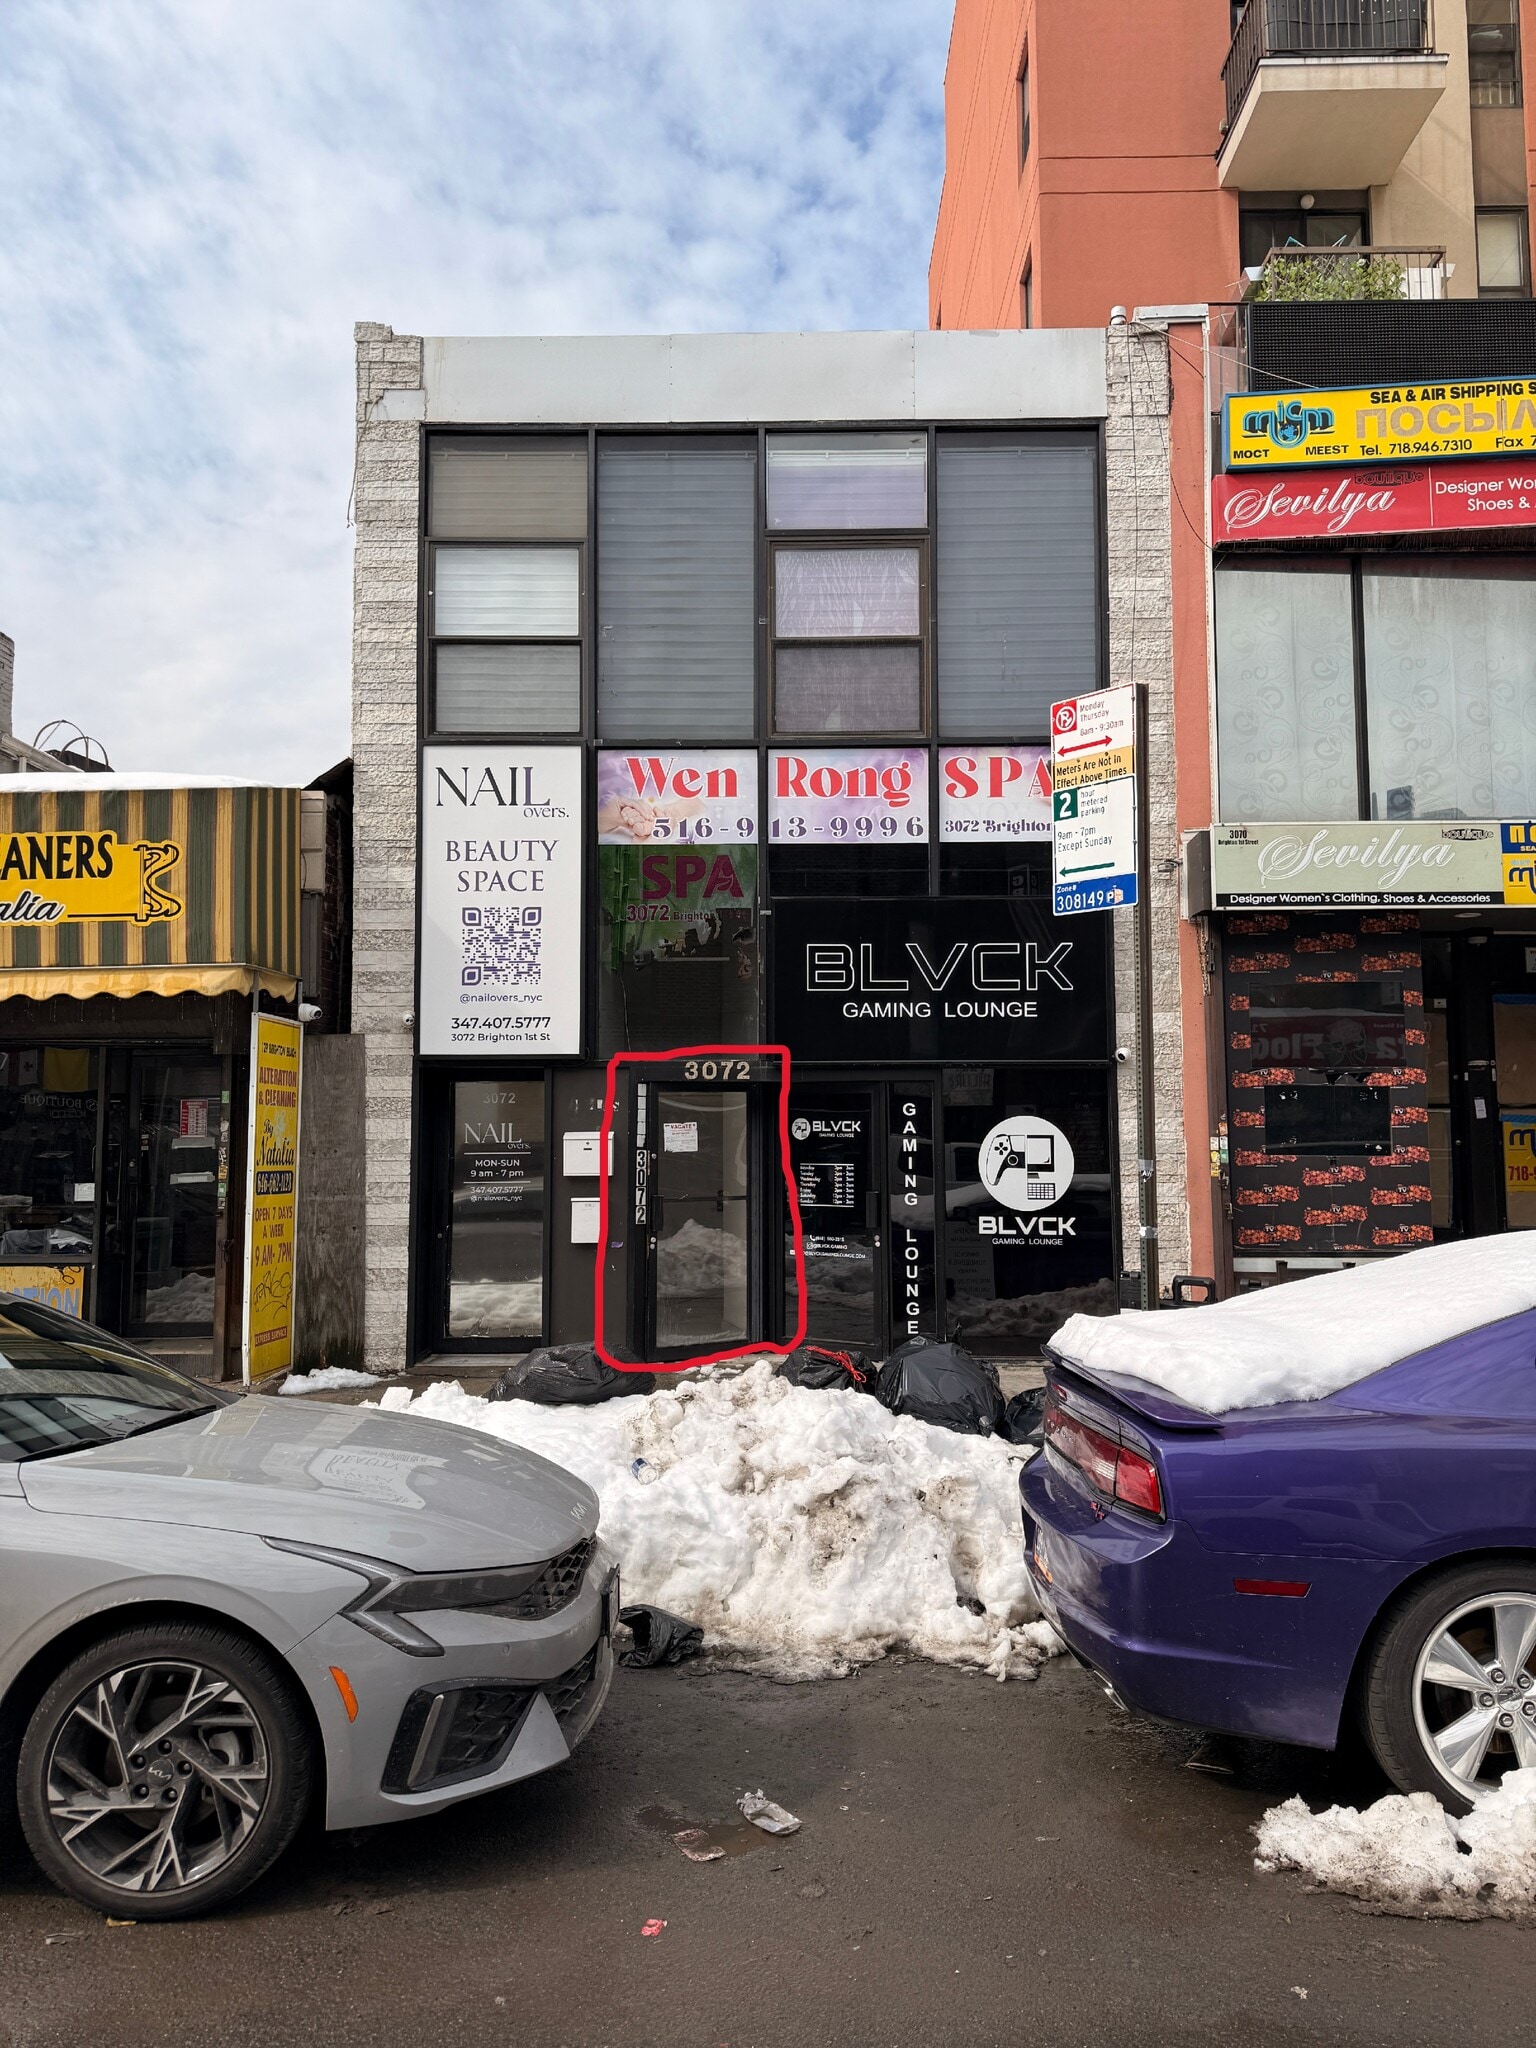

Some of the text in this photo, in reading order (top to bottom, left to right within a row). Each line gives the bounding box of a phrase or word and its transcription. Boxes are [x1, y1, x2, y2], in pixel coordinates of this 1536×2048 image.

[1370, 390, 1402, 404] SEA
[1405, 390, 1417, 402] &
[1421, 388, 1446, 401] AIR
[1450, 383, 1524, 400] SHIPPING
[1305, 444, 1350, 456] MEEST
[1360, 445, 1382, 456] Tel.
[1389, 439, 1473, 455] 718.946.7310
[1496, 435, 1524, 449] Fax
[1354, 470, 1424, 486] boutique
[1435, 477, 1536, 496] Designer Wo
[1223, 478, 1396, 535] Sevilya
[1467, 498, 1513, 512] Shoes
[1519, 498, 1527, 509] &
[1080, 700, 1105, 713] Monday
[1080, 709, 1110, 722] Thursday
[1100, 719, 1124, 732] 9:30am
[1056, 754, 1121, 776] Meters Are Not In
[435, 767, 551, 807] NAIL
[623, 757, 738, 799] Wen
[774, 756, 914, 808] Rong
[1056, 766, 1127, 790] Effect Above Times
[1080, 789, 1095, 799] hour
[1080, 795, 1108, 807] metered
[523, 807, 570, 818] overs.
[1059, 792, 1072, 818] 2
[1080, 805, 1105, 818] parking
[945, 819, 979, 833] 3072
[1057, 830, 1073, 840] 9am
[1080, 826, 1096, 838] 7pm
[1229, 830, 1247, 839] 3070
[1441, 828, 1494, 841] boutique
[445, 840, 560, 862] BEAUTY
[1058, 835, 1113, 853] Except Sunday
[0, 834, 113, 880] ANERS
[1257, 828, 1455, 889] Sevilya
[457, 869, 545, 893] SPACE
[641, 855, 745, 900] SPA
[1057, 890, 1104, 911] 308149
[1230, 894, 1277, 905] Designer
[1334, 892, 1381, 904] Clothing,
[1383, 894, 1415, 903] Shoes
[1418, 895, 1426, 903] &
[1429, 893, 1490, 903] Accessories
[627, 904, 670, 922] 3072
[806, 942, 1074, 991] BLVCK
[459, 993, 543, 1004] @nailovers_nyc
[843, 1002, 1038, 1018] GAMING LOUNGE
[451, 1017, 551, 1029] 347.407.5777
[451, 1032, 551, 1043] 3072 Brighton 1st St
[259, 1067, 298, 1088] ALTERATION
[684, 1061, 751, 1080] 3072
[259, 1089, 296, 1108] & CLEANING
[483, 1093, 516, 1104] 3072
[264, 1119, 274, 1138] By
[464, 1122, 522, 1144] NAIL
[812, 1121, 861, 1132] BLVCK
[256, 1136, 295, 1166] Natalia
[475, 1159, 520, 1167] MON-SUN
[1508, 1166, 1536, 1181] 718-
[636, 1150, 646, 1224] 3072
[255, 1205, 293, 1222] OPEN 7 DAYS
[902, 1102, 920, 1335] GAMING LOUNGE
[262, 1223, 284, 1239] A WEEK
[978, 1216, 1076, 1236] BLVCK
[1029, 1238, 1063, 1246] LOUNGE
[255, 1246, 260, 1267] 9
[278, 1242, 292, 1264] 7PM
